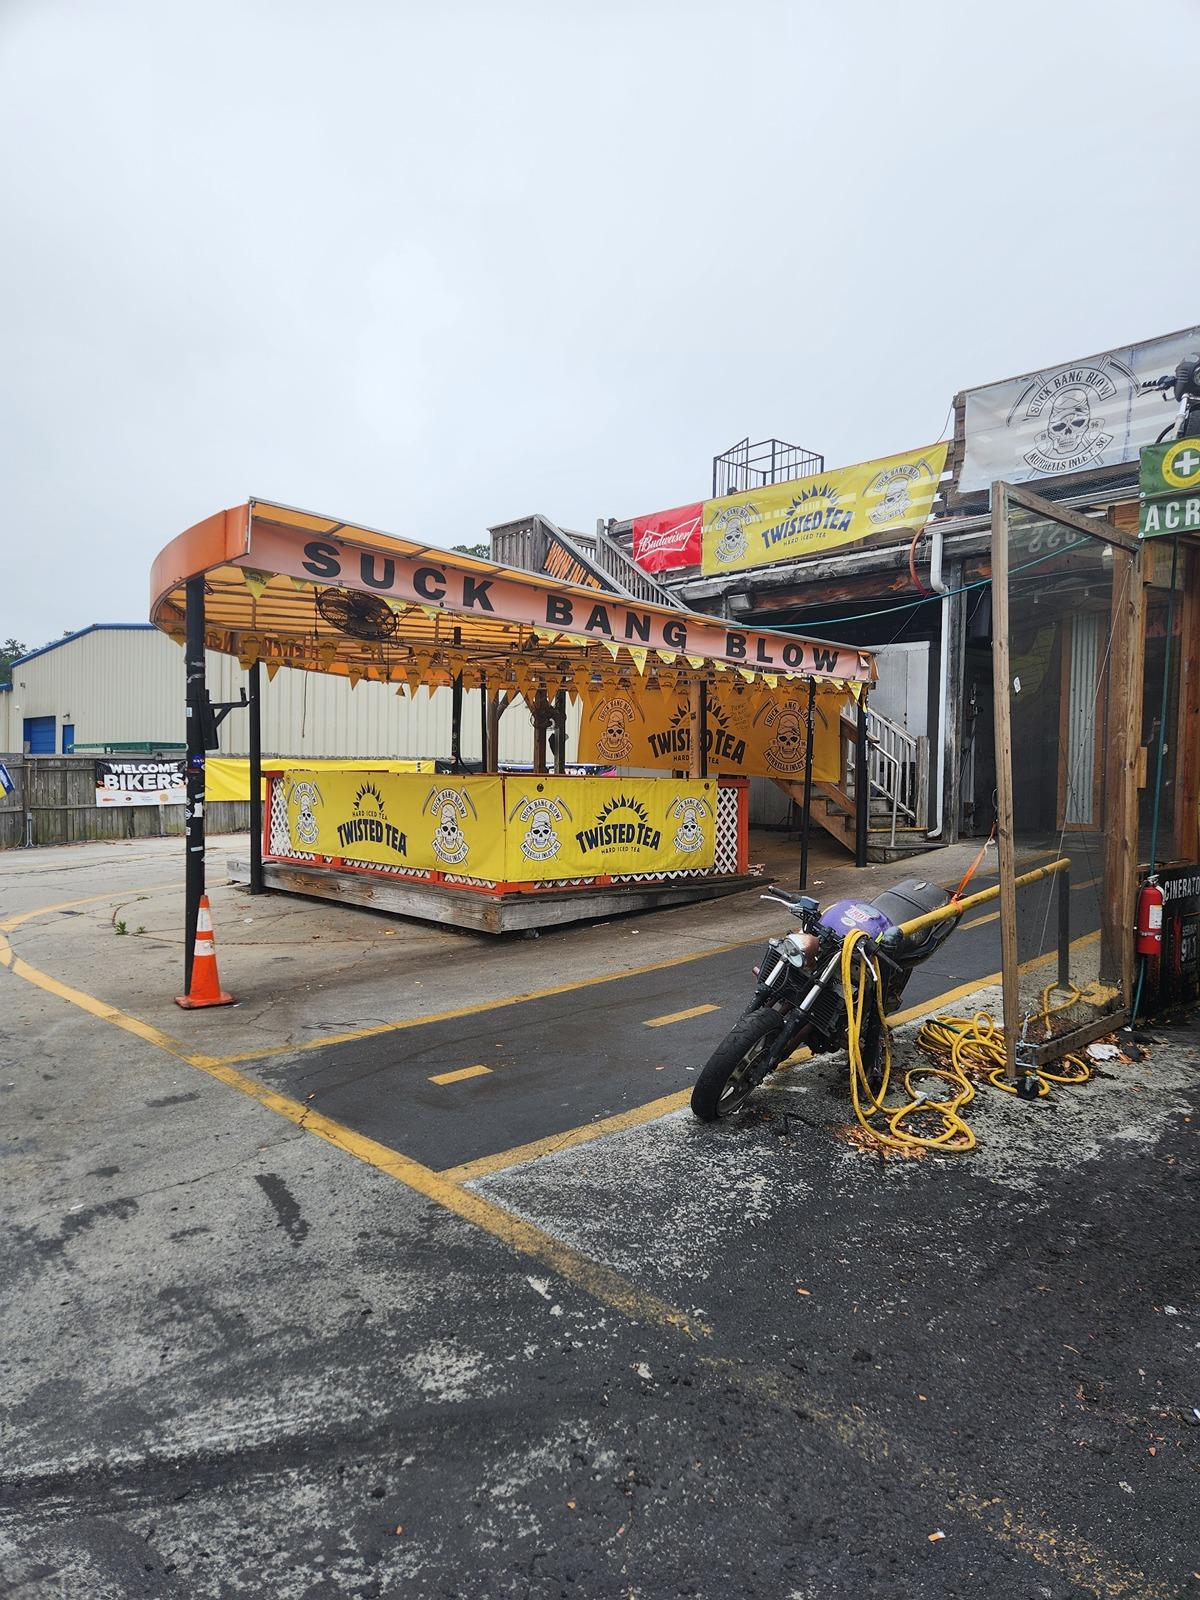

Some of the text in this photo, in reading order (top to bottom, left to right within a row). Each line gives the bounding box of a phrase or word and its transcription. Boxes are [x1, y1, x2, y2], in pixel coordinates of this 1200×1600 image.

[1031, 370, 1112, 414] SUCK BANG BLOW
[639, 531, 691, 552] Budweiser
[761, 510, 823, 549] TWISTED
[823, 507, 854, 532] TEA
[302, 541, 841, 673] SUCK BANG BLOW
[715, 728, 746, 765] TEA
[103, 772, 184, 791] BIKERS
[109, 762, 178, 774] WELCOME
[337, 818, 383, 848] TWISTED
[384, 823, 407, 857] TEA
[575, 823, 636, 854] TWISTED
[636, 822, 661, 851] TEA
